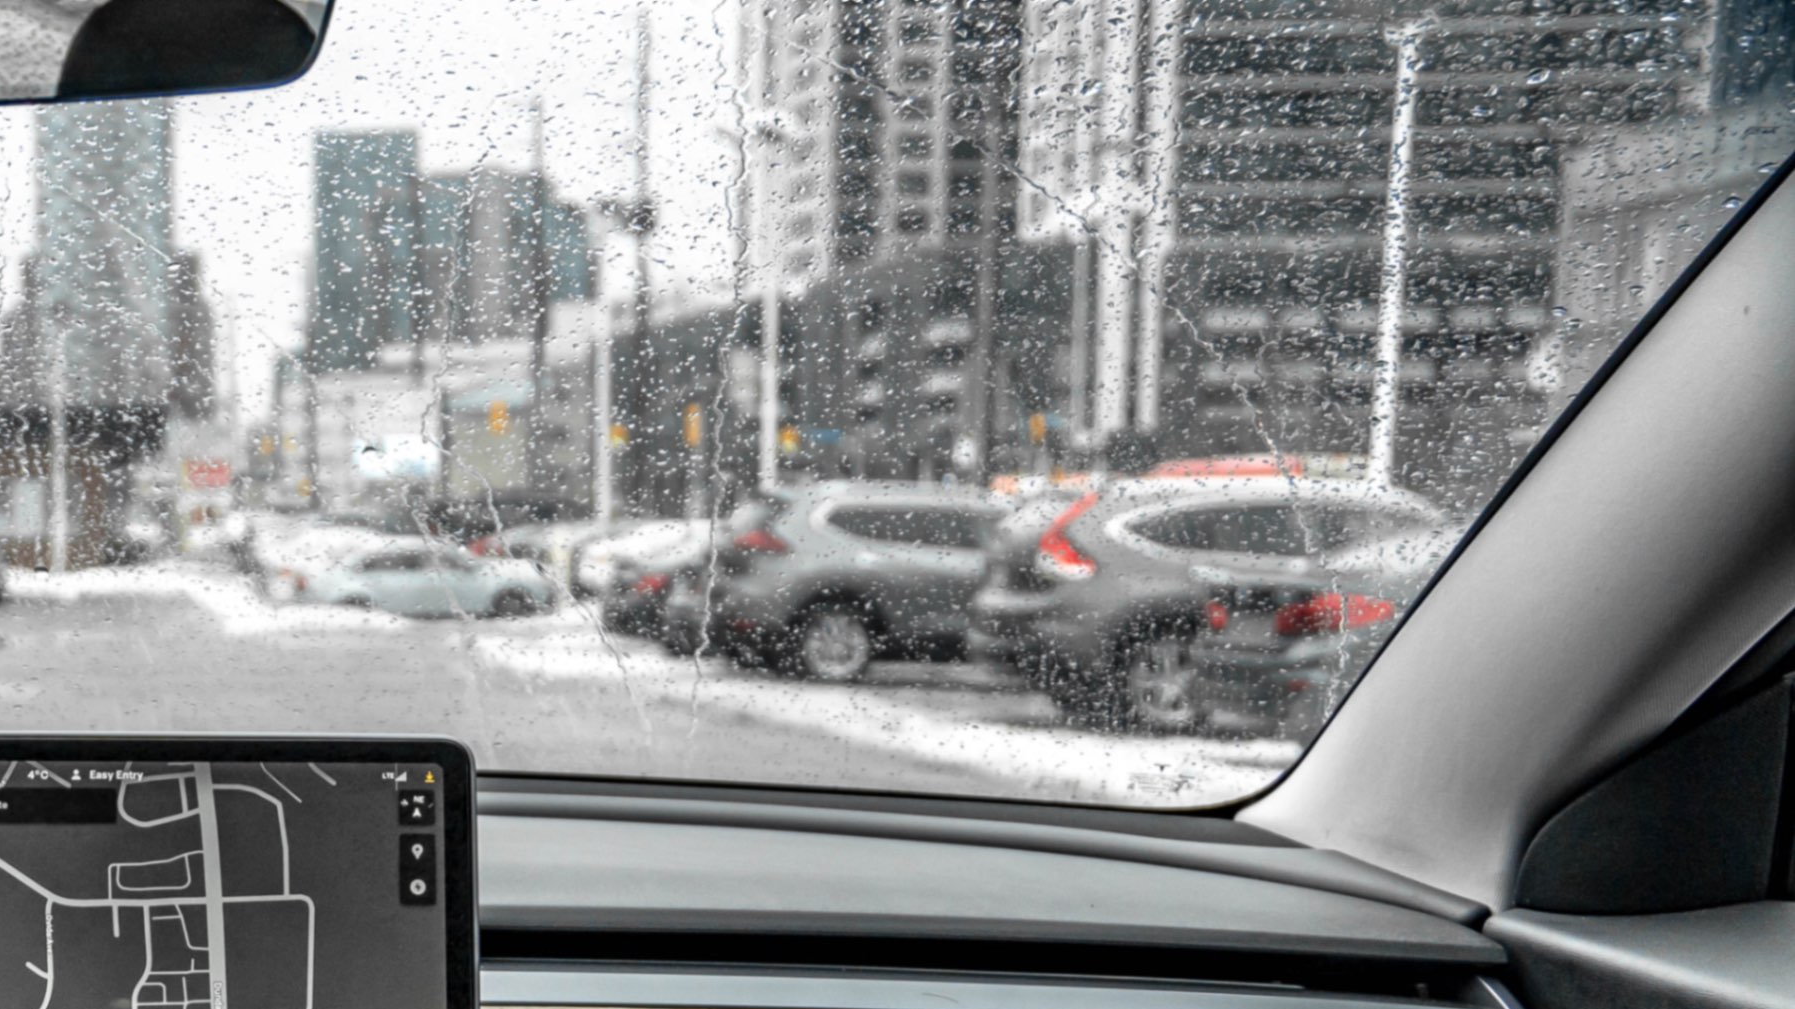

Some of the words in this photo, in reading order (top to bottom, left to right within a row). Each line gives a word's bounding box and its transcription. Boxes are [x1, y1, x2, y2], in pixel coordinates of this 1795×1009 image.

[89, 769, 114, 782] Easy
[116, 769, 144, 782] Entry
[381, 772, 395, 780] LTE
